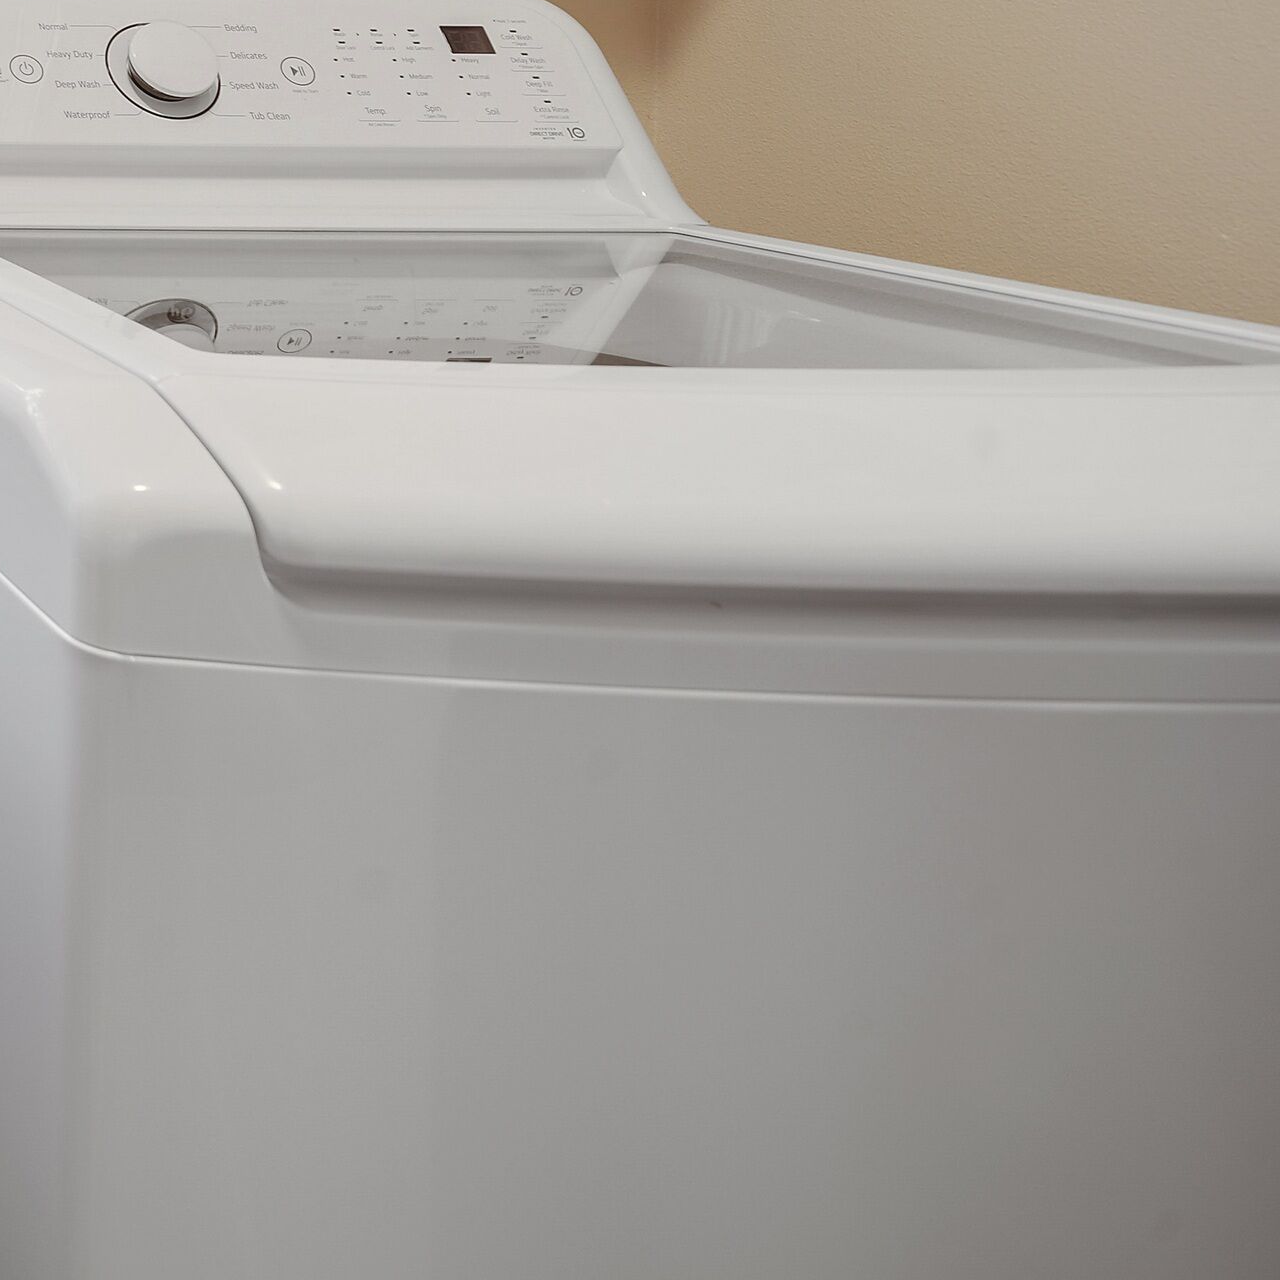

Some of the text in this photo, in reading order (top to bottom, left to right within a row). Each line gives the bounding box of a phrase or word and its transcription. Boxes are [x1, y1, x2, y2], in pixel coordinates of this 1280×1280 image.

[38, 23, 68, 31] Normal
[224, 24, 258, 33] Bedding
[46, 50, 93, 59] Heavy Duty
[230, 52, 267, 60] Delicates
[55, 80, 101, 89] Deep Wash
[229, 82, 255, 91] Speed
[424, 104, 442, 113] Spin
[485, 107, 500, 116] Soil
[64, 110, 111, 120] Waterproof
[249, 112, 291, 120] Tub Clean
